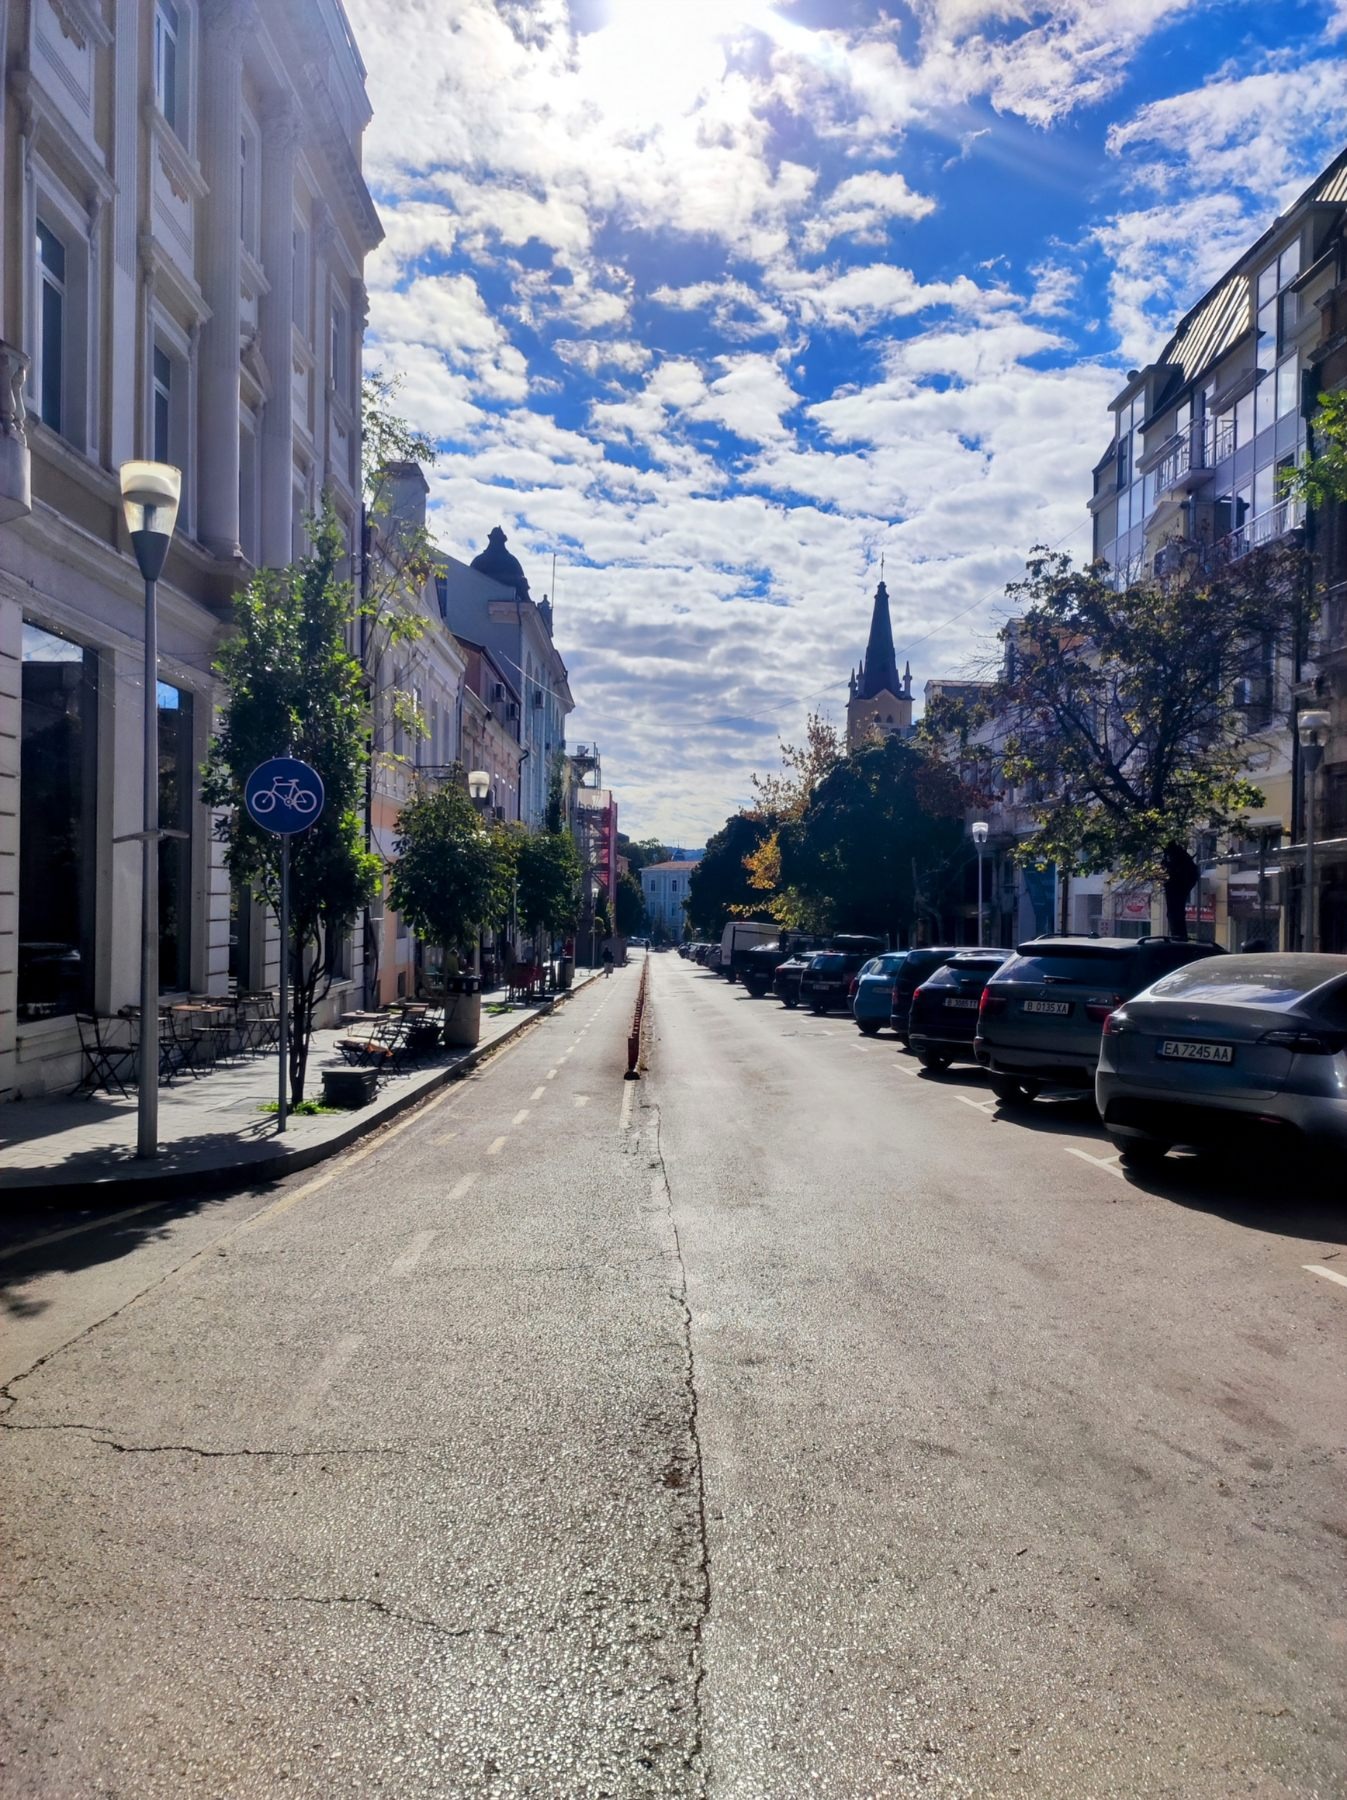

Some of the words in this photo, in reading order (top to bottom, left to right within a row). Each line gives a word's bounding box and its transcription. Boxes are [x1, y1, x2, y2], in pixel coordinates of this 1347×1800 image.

[1026, 1001, 1033, 1011] B
[1036, 1002, 1056, 1012] 0135
[1056, 1003, 1067, 1014] XA
[1165, 1042, 1180, 1056] EA
[1181, 1044, 1211, 1059] 7245
[1212, 1047, 1230, 1060] AA
